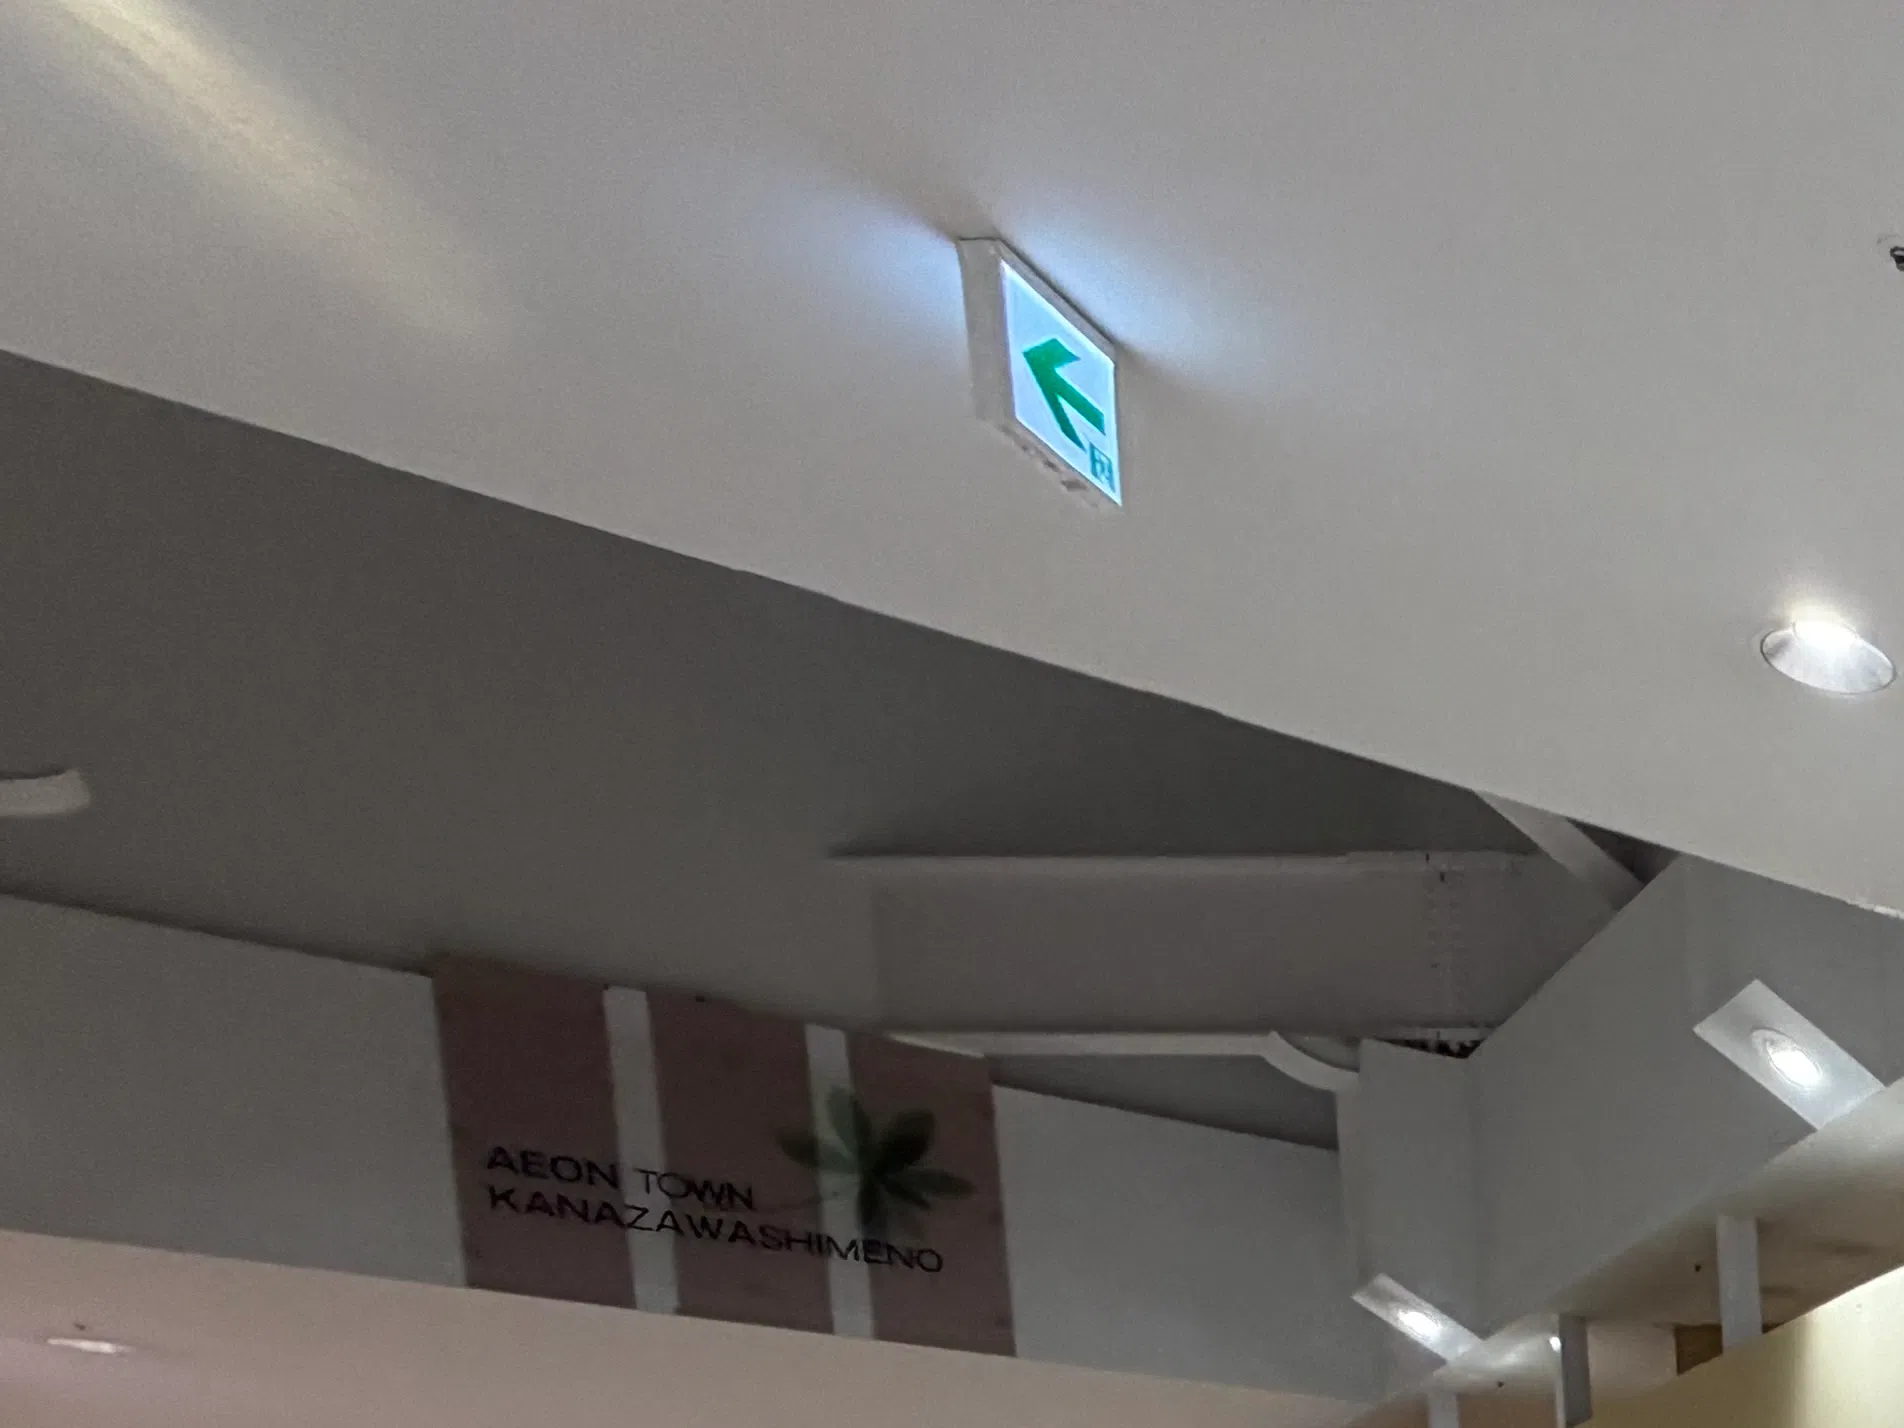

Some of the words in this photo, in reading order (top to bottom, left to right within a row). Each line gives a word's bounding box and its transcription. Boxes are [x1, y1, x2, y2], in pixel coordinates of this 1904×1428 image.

[486, 1145, 621, 1191] AEON
[633, 1167, 755, 1210] TOWN
[486, 1185, 944, 1274] KANAZAWASHIMENO
